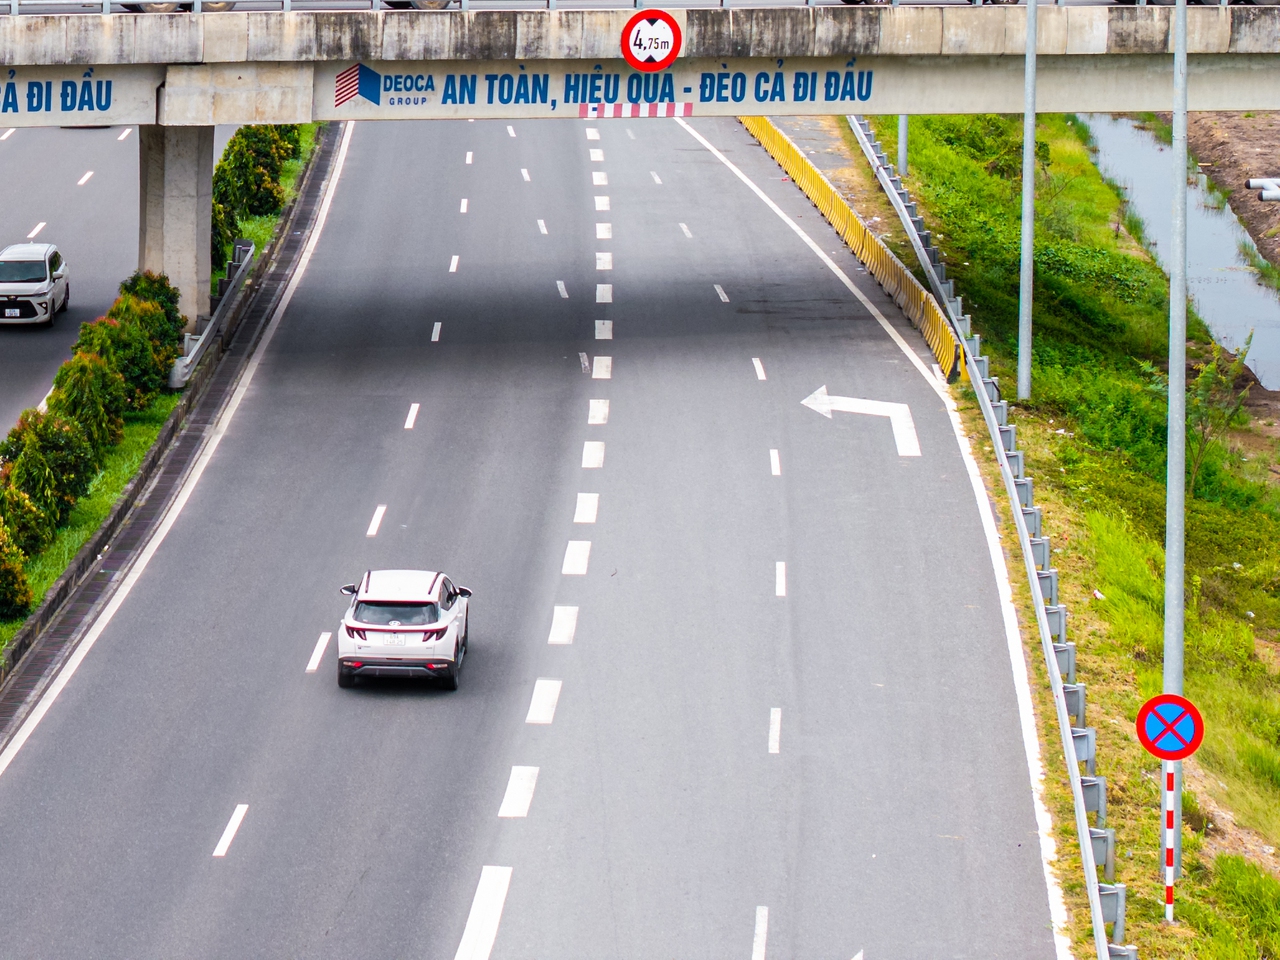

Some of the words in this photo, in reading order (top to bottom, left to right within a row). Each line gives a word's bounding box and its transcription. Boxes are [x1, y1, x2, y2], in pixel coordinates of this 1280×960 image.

[27, 81, 52, 112] ĐI
[60, 67, 112, 111] ĐẦU
[384, 74, 434, 92] DEOCA
[441, 74, 477, 104] AN
[485, 65, 557, 110] TOÀN,
[564, 64, 619, 112] HIỆU
[700, 63, 746, 102] ĐÈO
[754, 59, 785, 102] CẢ
[793, 72, 817, 102] ĐI
[389, 97, 427, 106] GROUP
